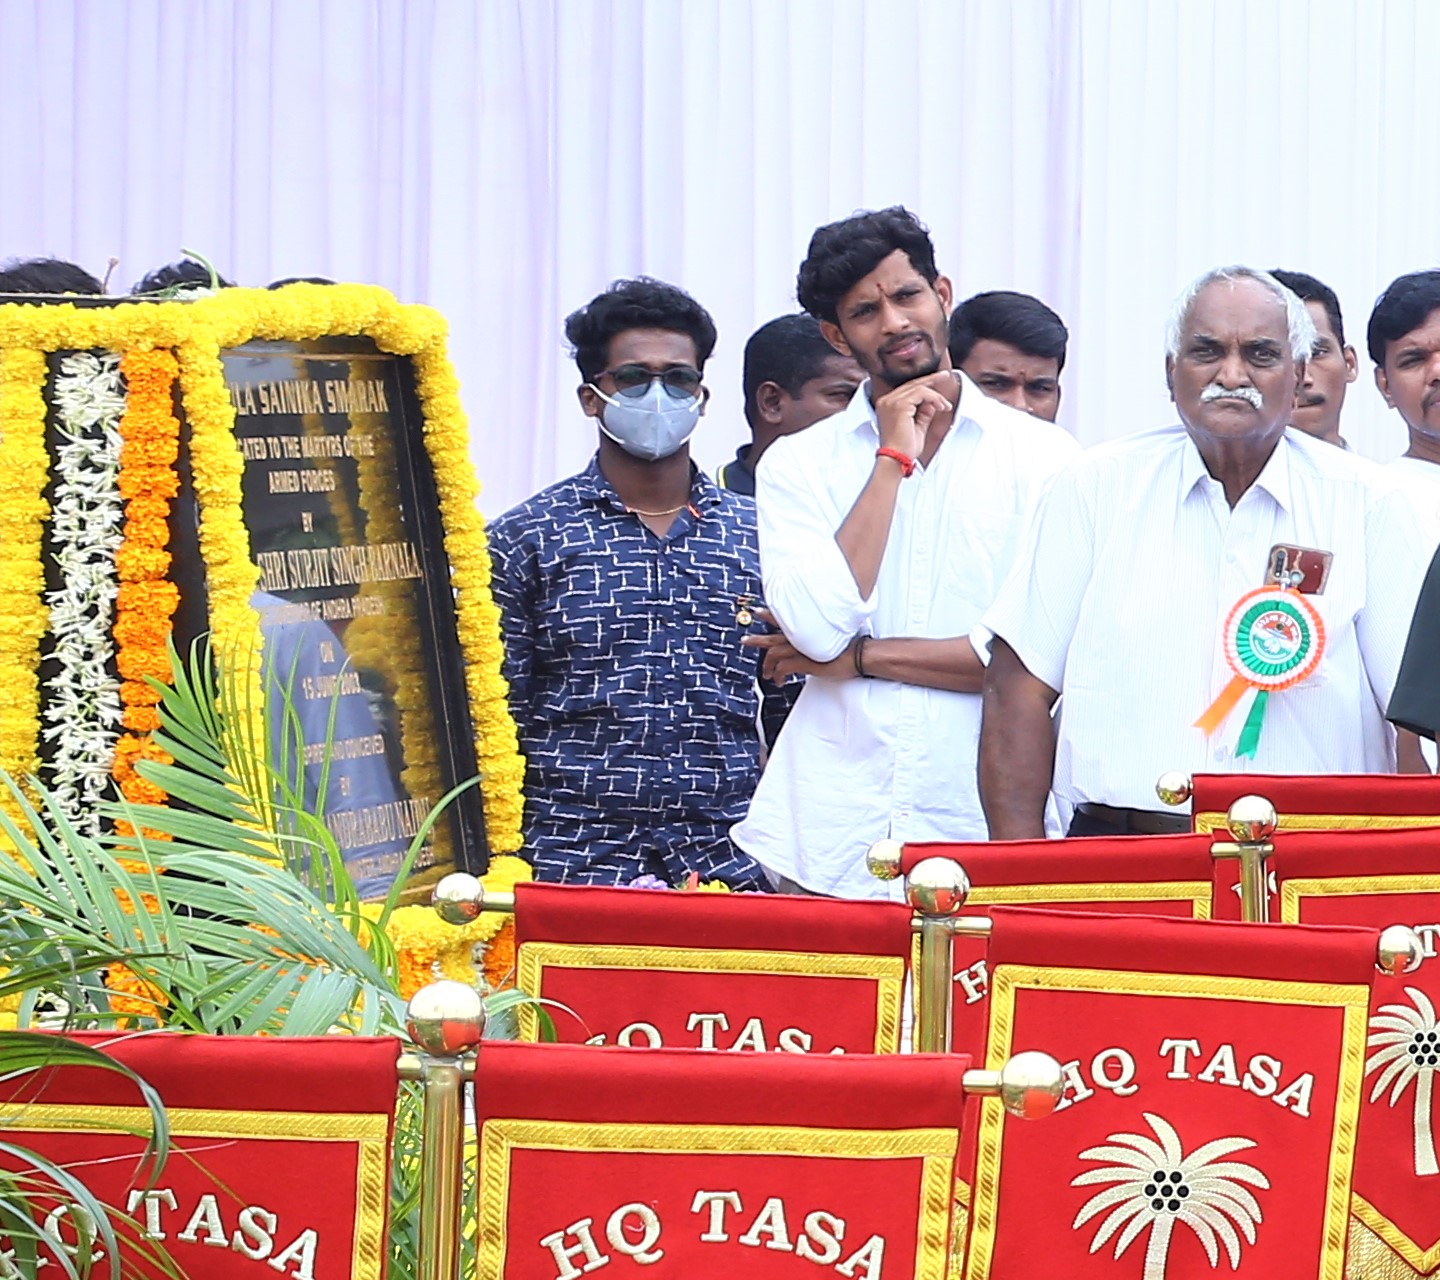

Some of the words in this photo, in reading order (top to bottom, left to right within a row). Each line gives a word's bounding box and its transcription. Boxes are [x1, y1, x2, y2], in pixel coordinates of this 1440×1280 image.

[259, 380, 324, 414] SAINIKA
[325, 379, 389, 413] SMARAK
[267, 436, 281, 459] TO
[282, 435, 301, 459] THE
[301, 434, 343, 458] MARTYRS
[357, 433, 375, 456] THE
[268, 470, 299, 494] ARMED
[300, 469, 336, 493] FORCES
[301, 511, 313, 533] BY
[256, 550, 289, 592] SHRI
[287, 548, 332, 590] SURJIT
[330, 544, 369, 586] SINGH
[319, 640, 335, 664] ON
[302, 676, 315, 700] 15
[686, 1012, 846, 1055] TAS
[1158, 1038, 1315, 1118] TASA
